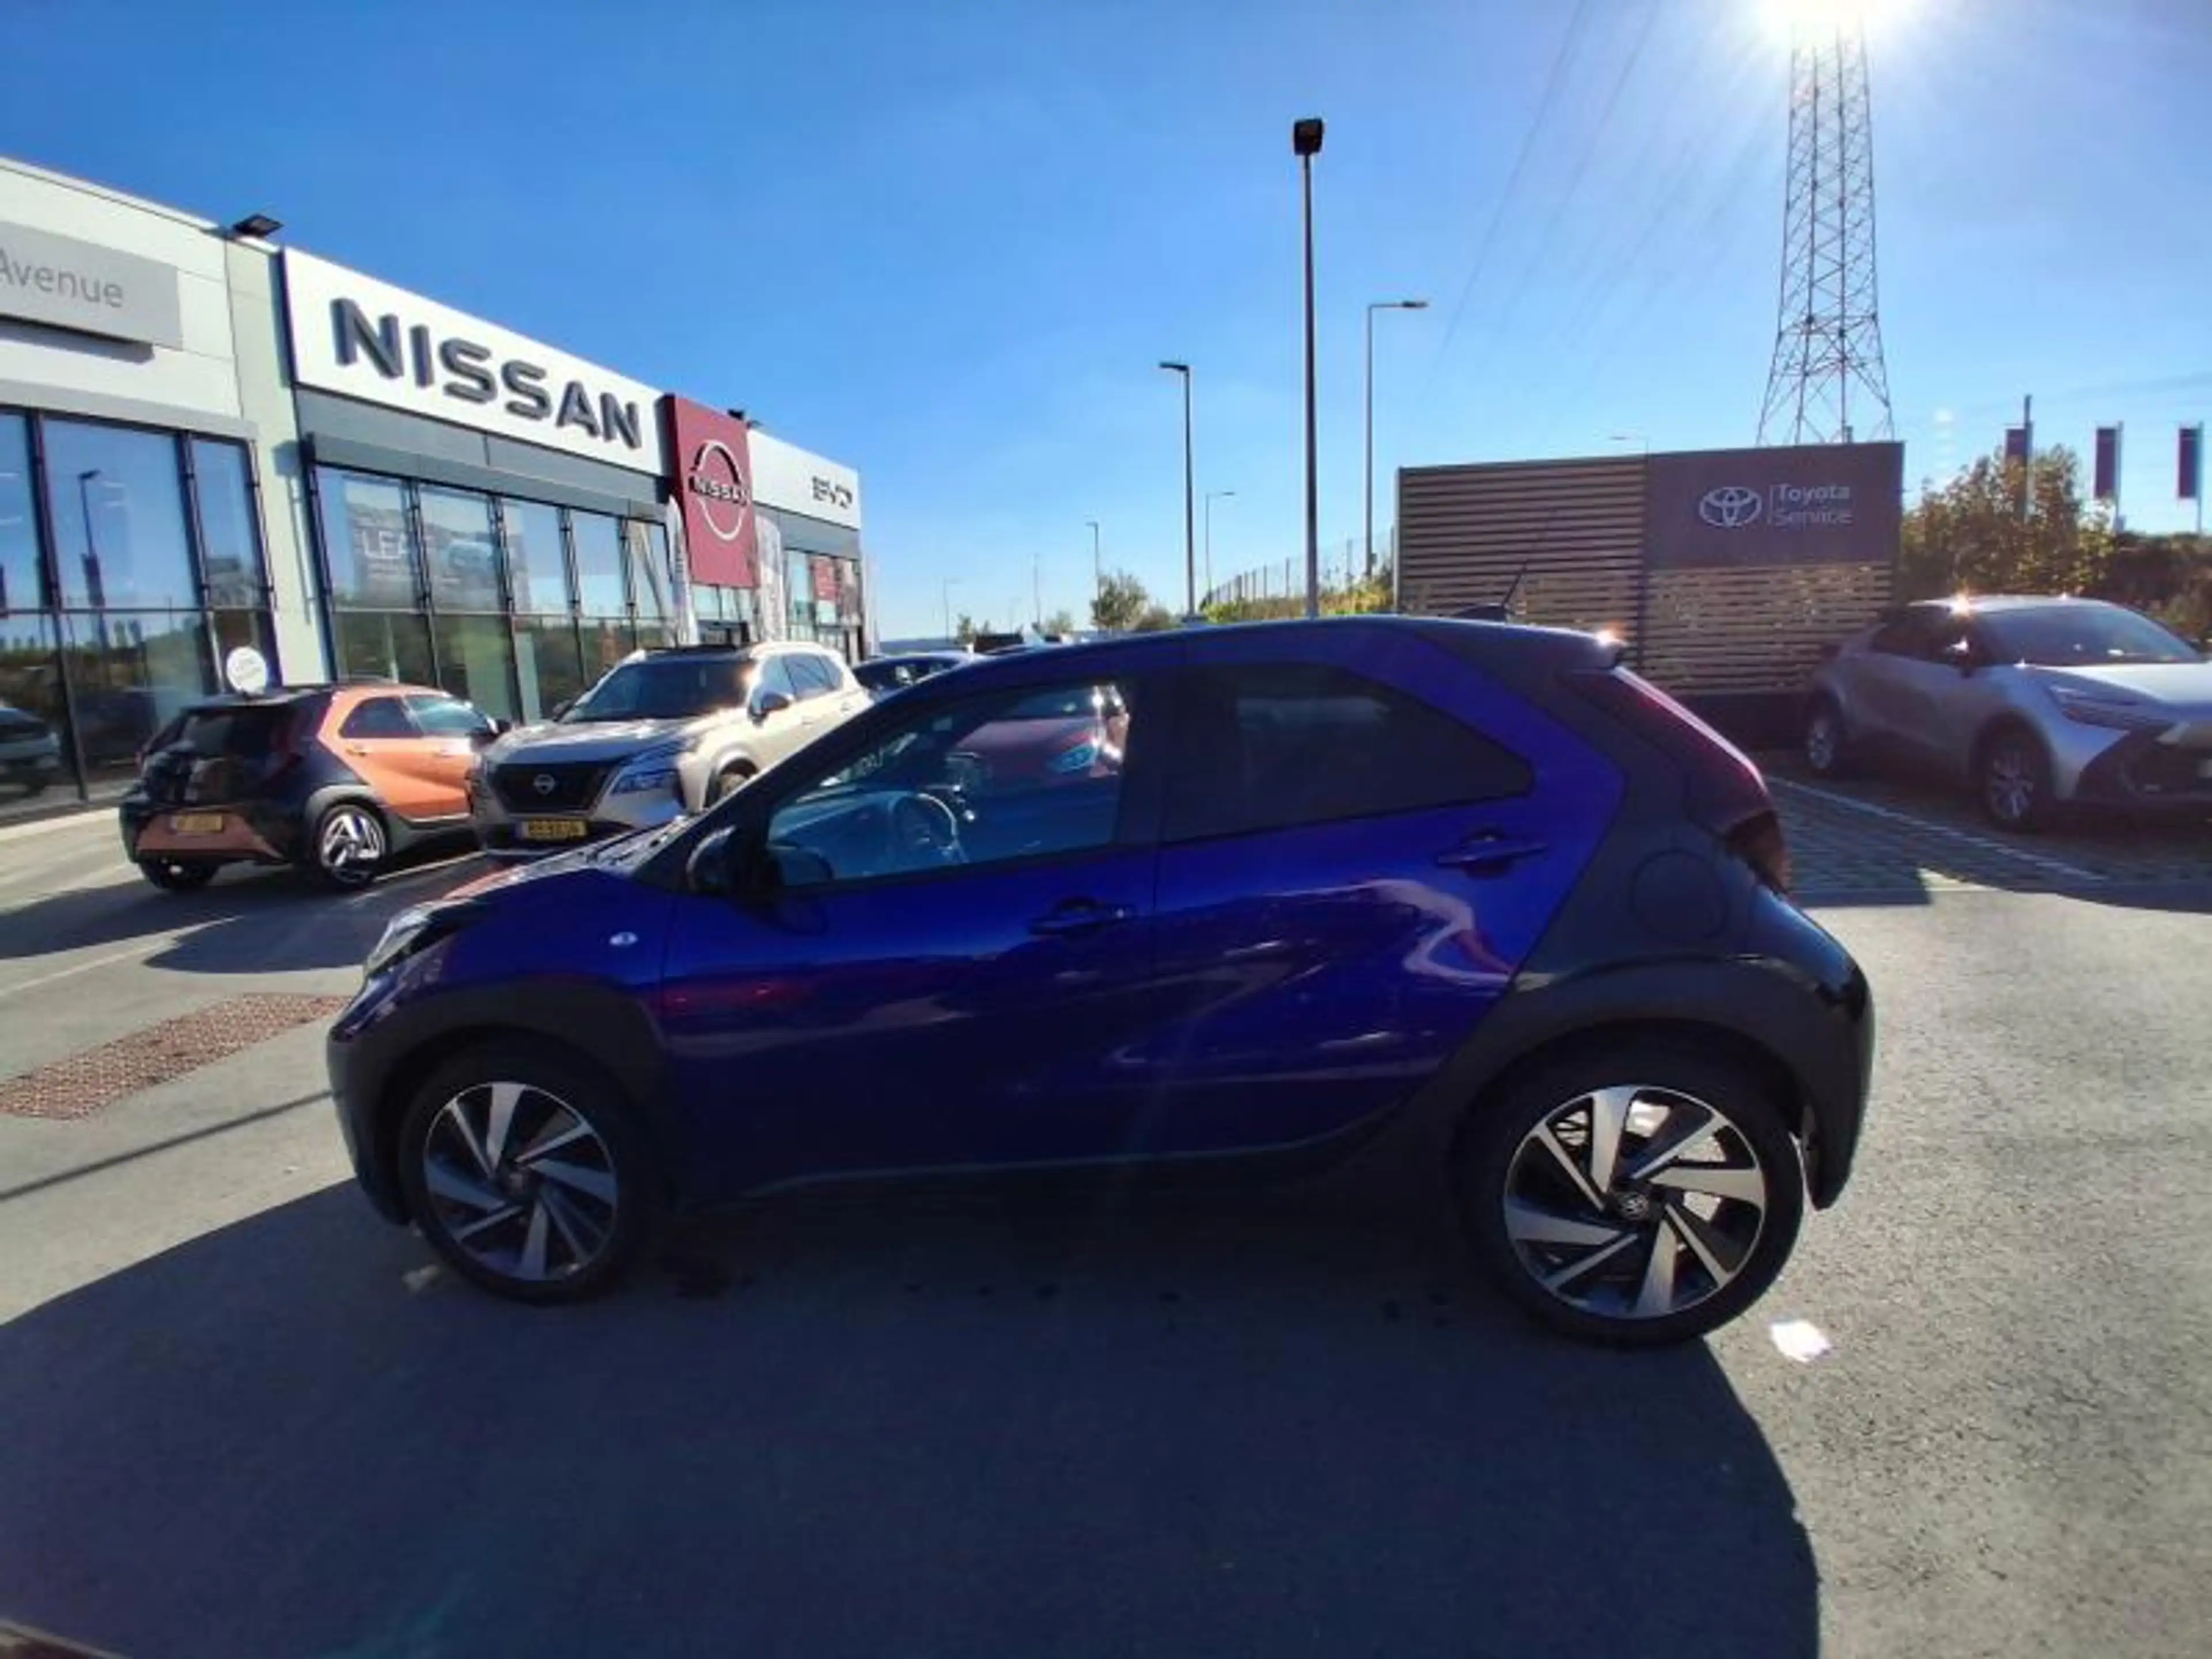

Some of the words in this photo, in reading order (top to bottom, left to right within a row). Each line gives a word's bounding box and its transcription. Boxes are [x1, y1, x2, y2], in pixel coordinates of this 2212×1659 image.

[0, 246, 123, 308] Avenue
[330, 297, 642, 449] NISSAN
[692, 476, 749, 506] NISSAN
[1778, 483, 1850, 505] Toyota
[1775, 507, 1854, 528] Service
